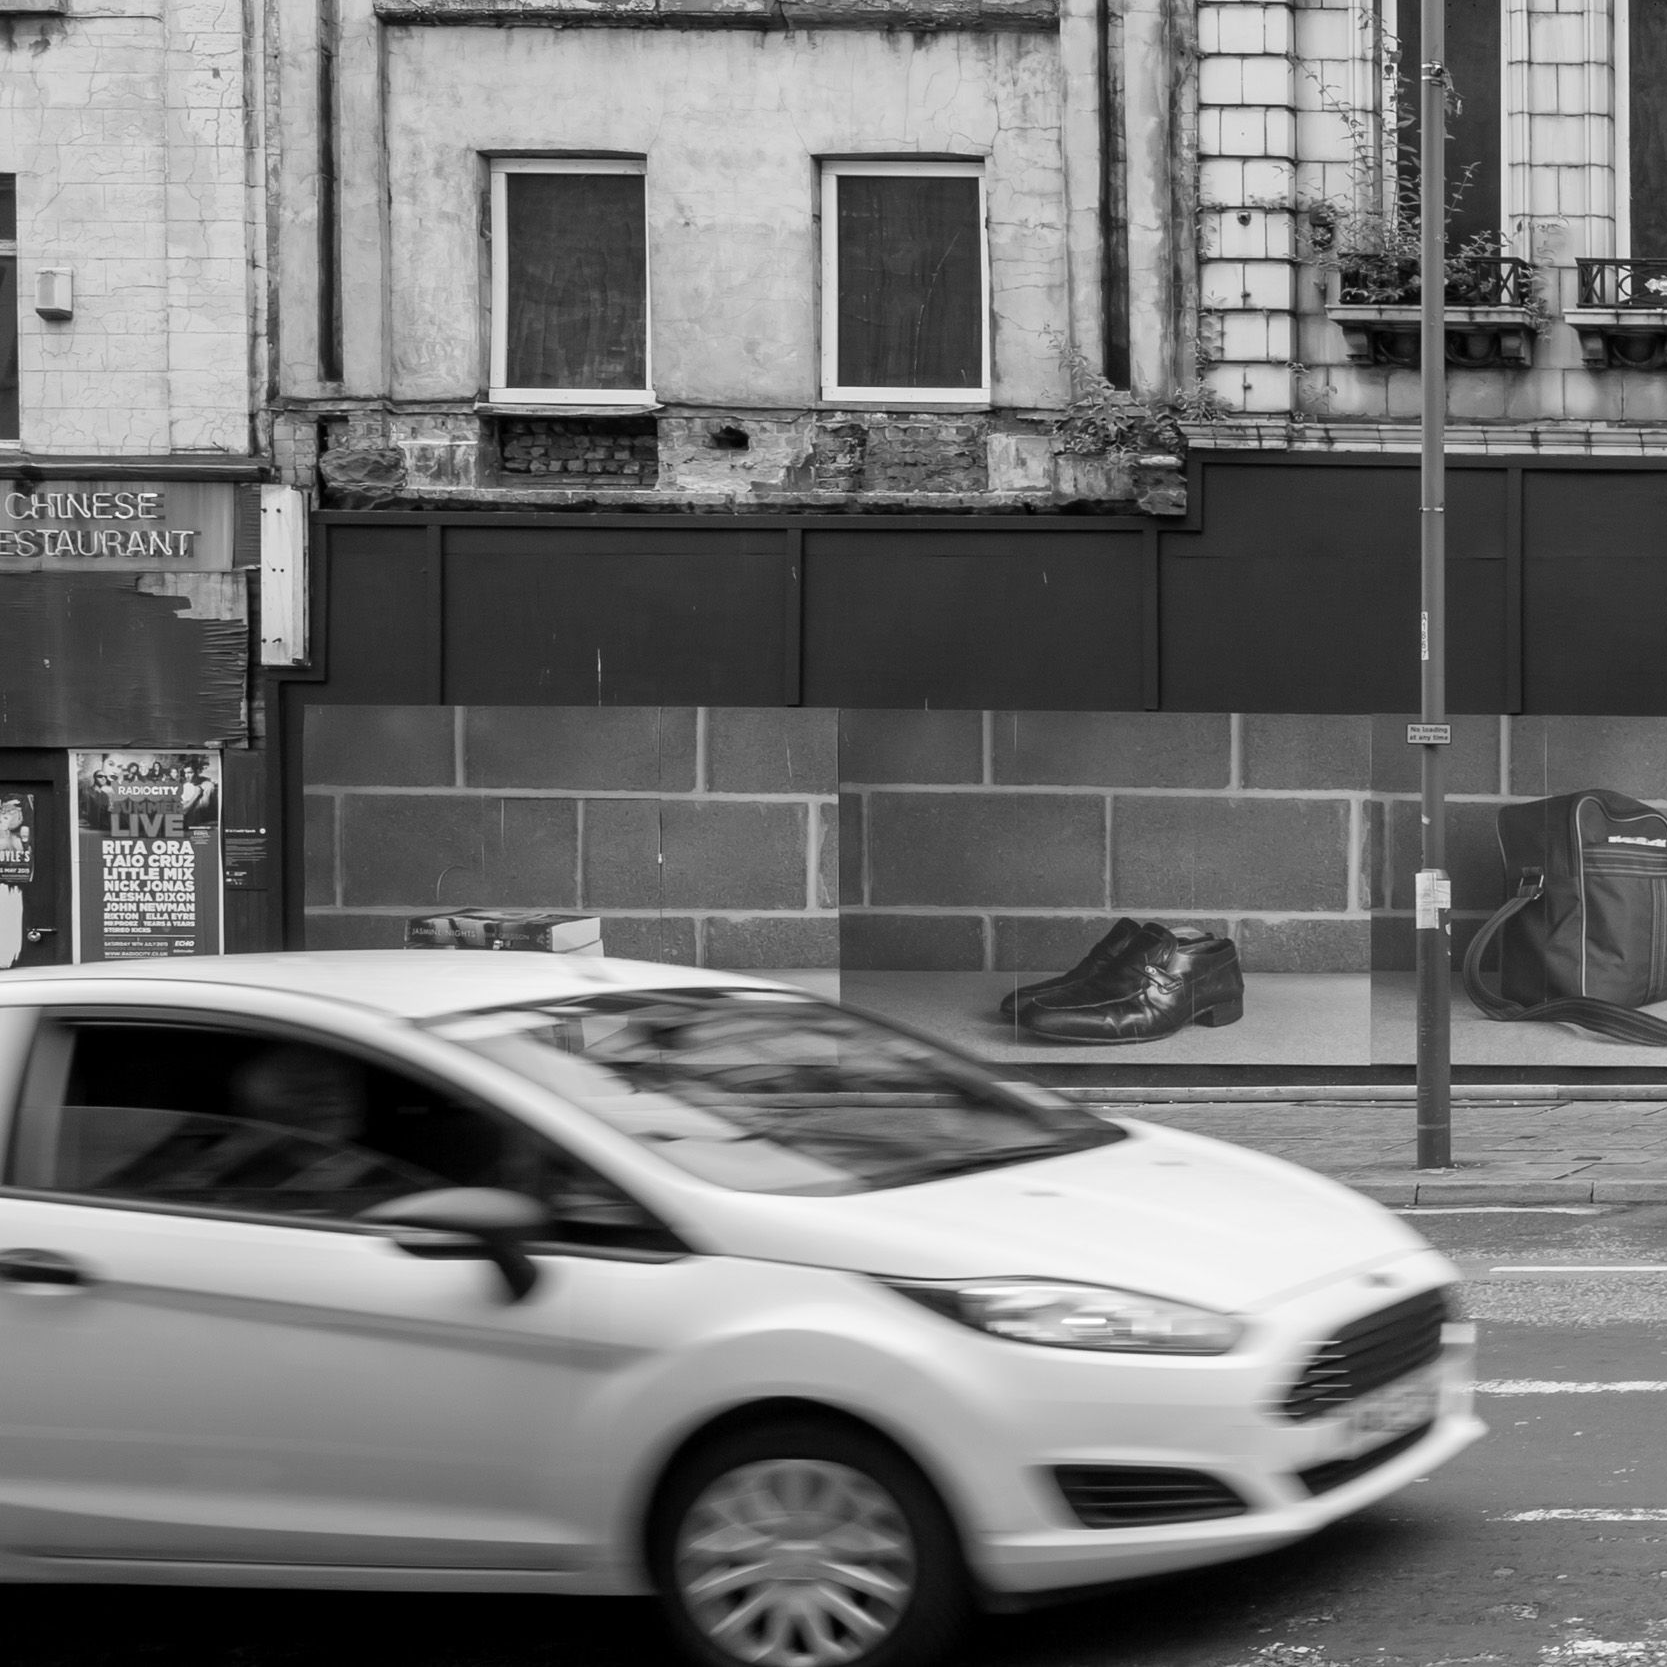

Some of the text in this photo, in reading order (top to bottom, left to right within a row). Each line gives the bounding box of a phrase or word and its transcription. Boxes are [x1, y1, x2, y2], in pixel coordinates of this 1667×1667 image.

[5, 492, 160, 519] CHINESE
[118, 786, 178, 795] RADIOCITY
[112, 801, 183, 813] SUMMER
[110, 813, 184, 837] LIVE
[102, 840, 194, 854] RITA ORA
[103, 855, 195, 867] TAIO CRUZ
[103, 868, 194, 880] LITTLE MIX
[104, 880, 195, 892] NICK JONAS
[103, 892, 195, 902] ALESHA DIXON
[104, 903, 195, 912] JOHN NEWMAN
[446, 930, 476, 938] NIGHTS
